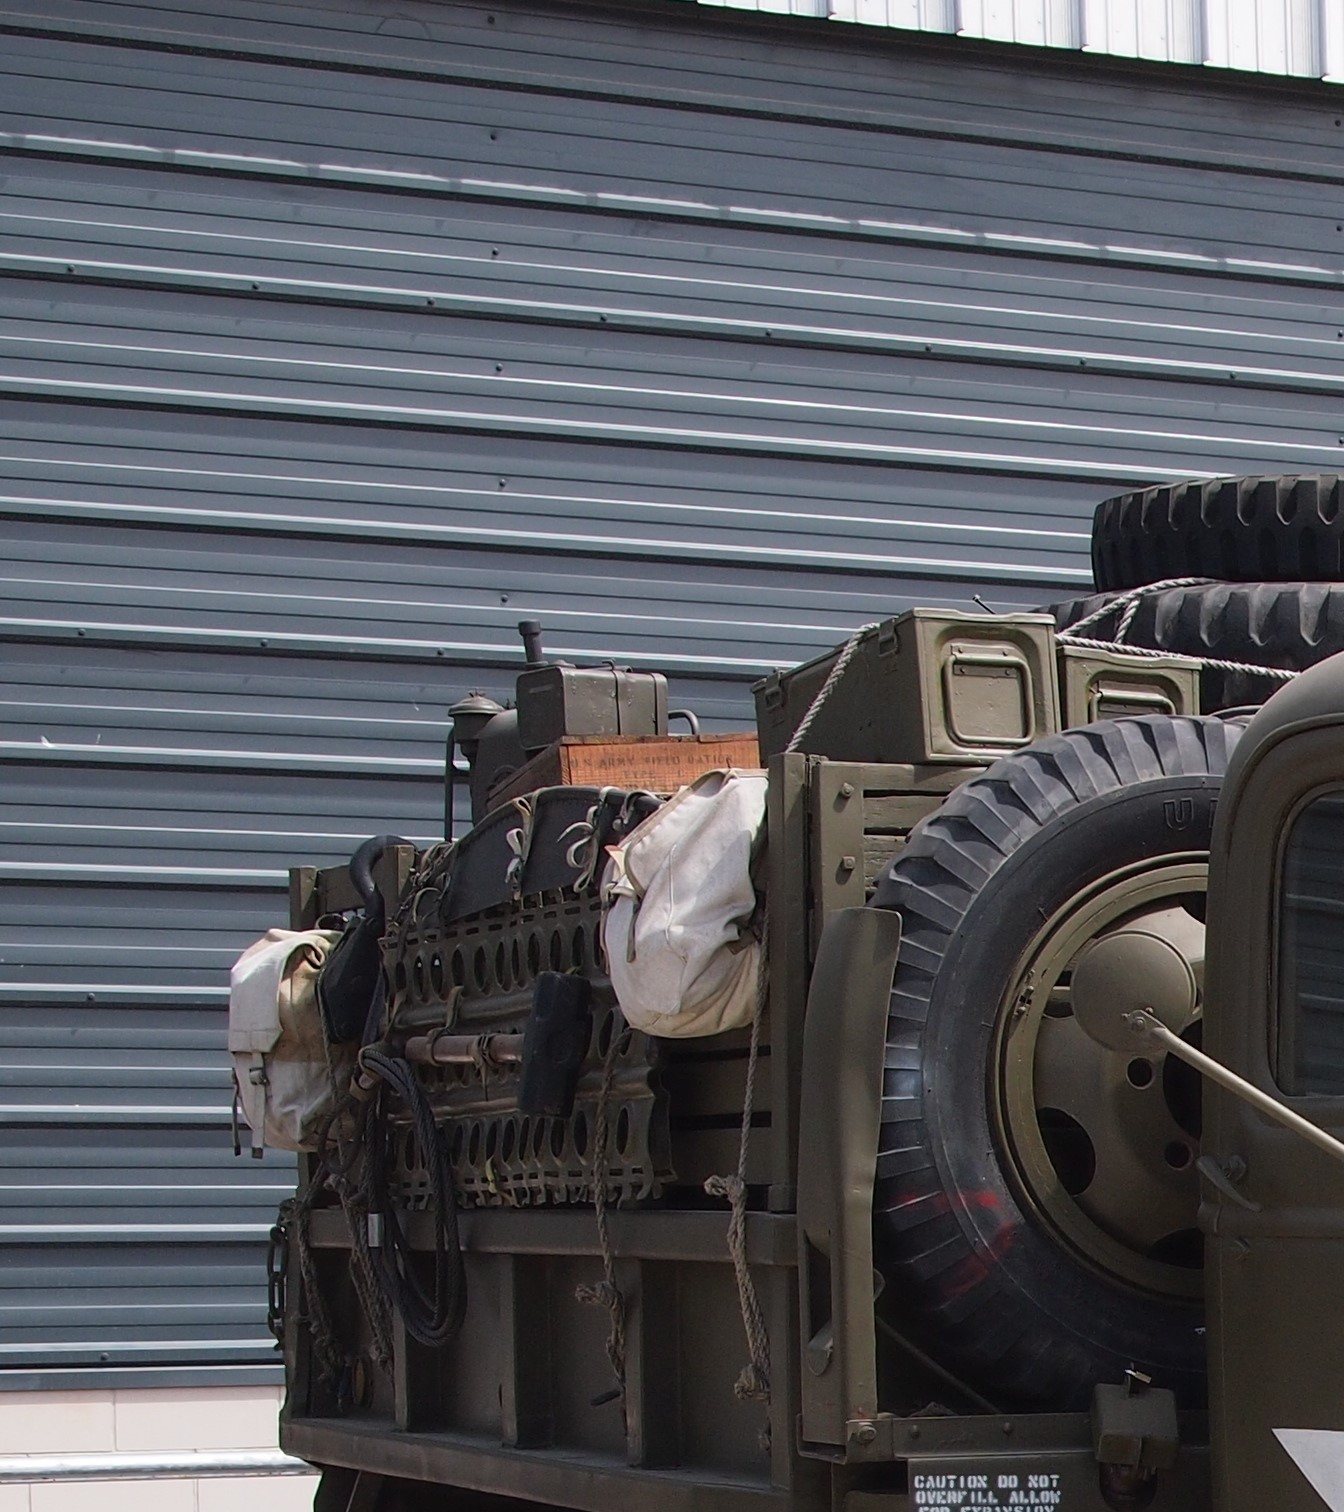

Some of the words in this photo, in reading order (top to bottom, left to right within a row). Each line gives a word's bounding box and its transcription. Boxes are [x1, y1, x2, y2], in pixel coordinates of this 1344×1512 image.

[914, 1474, 988, 1489] CAUTION
[997, 1474, 1018, 1489] DO
[1028, 1474, 1060, 1488] NOT
[915, 1490, 998, 1504] OVERFILL
[1009, 1490, 1062, 1504] ALLOW
